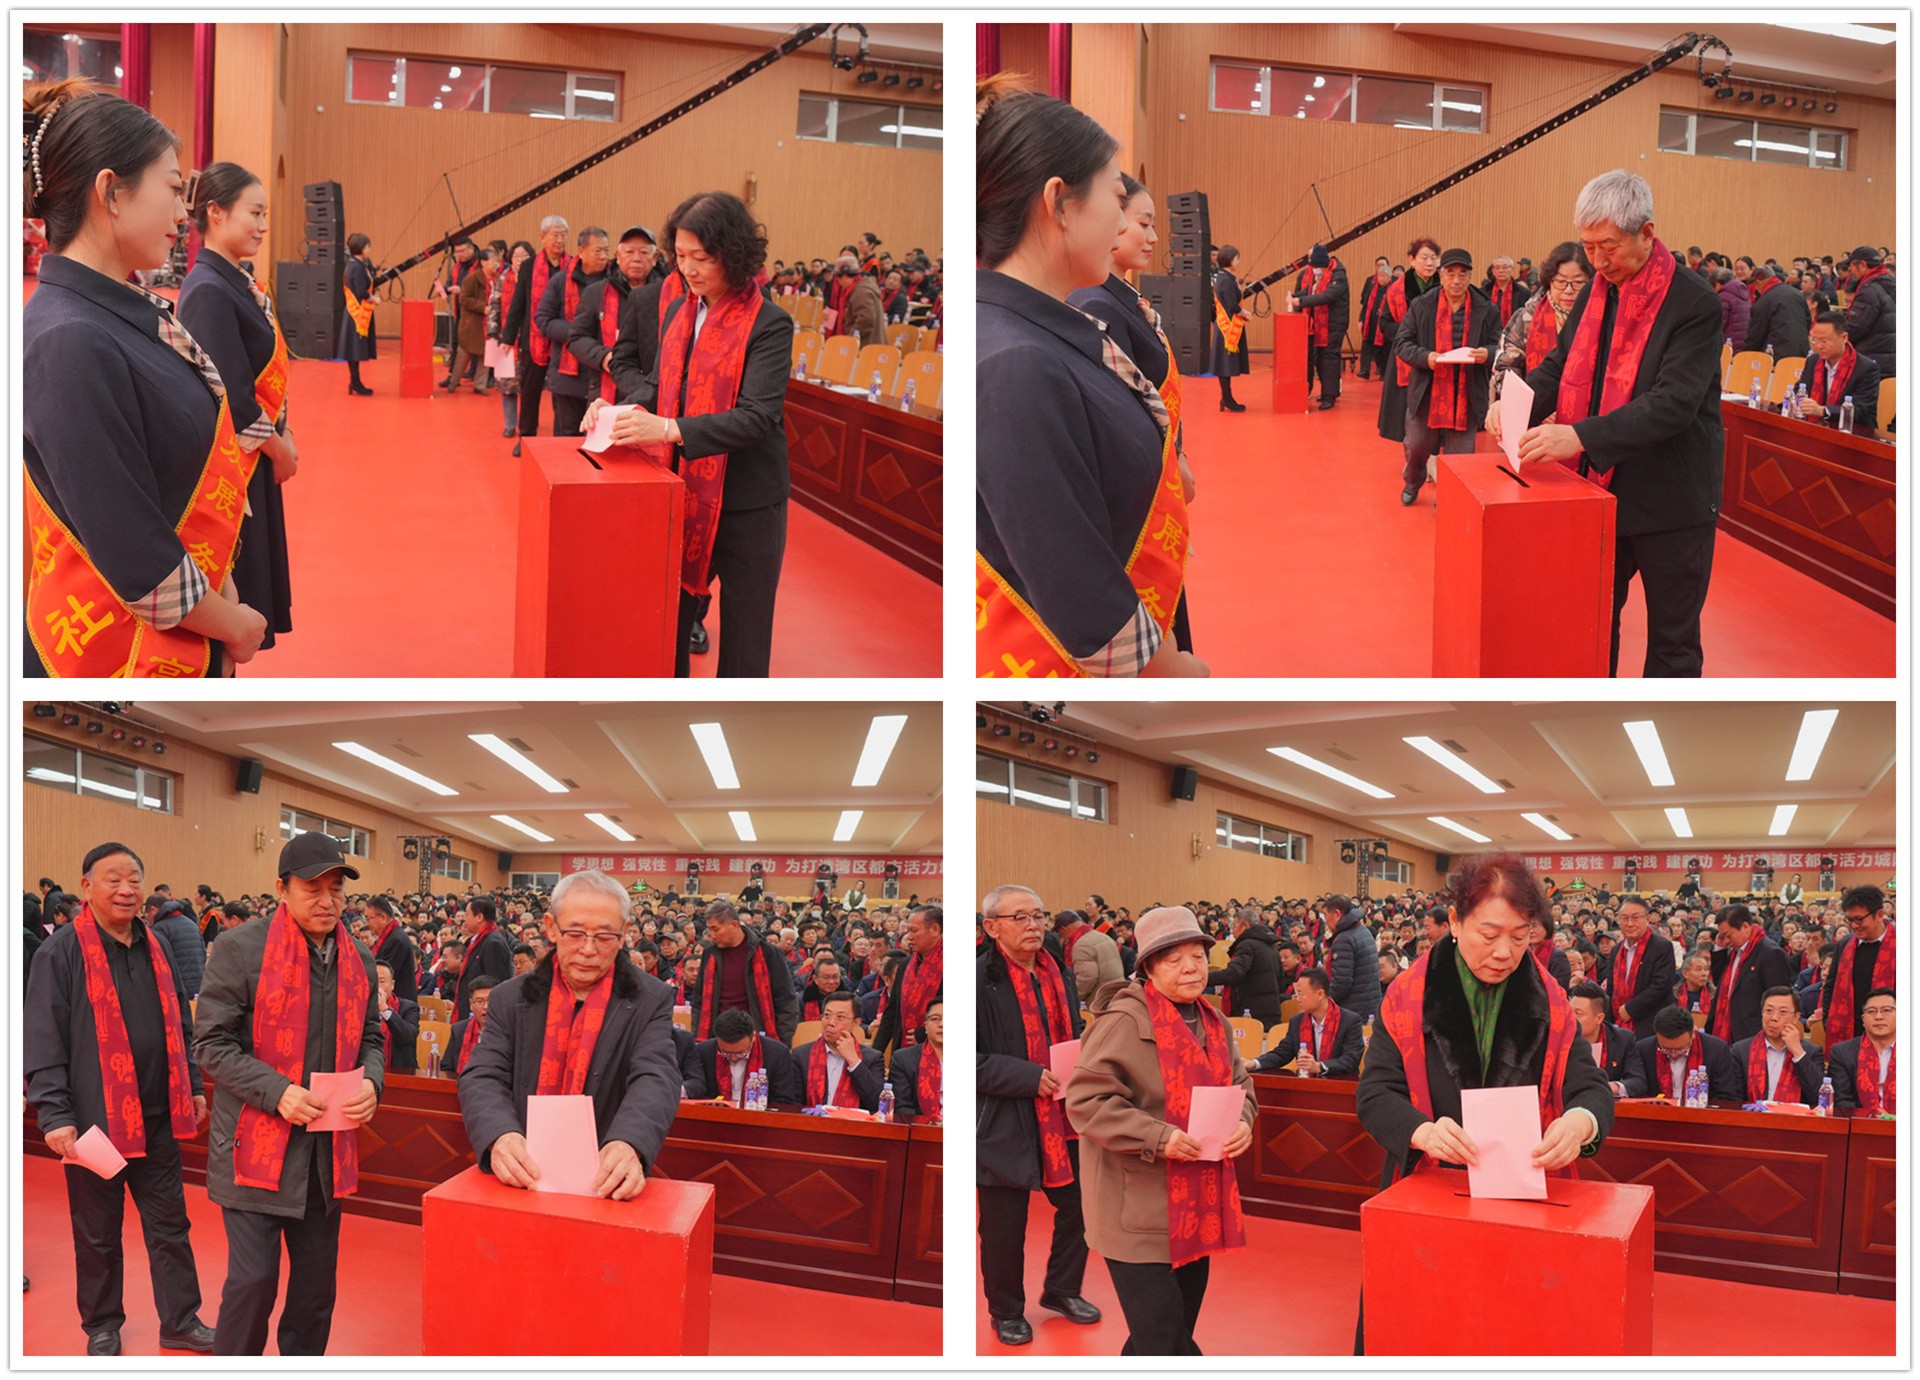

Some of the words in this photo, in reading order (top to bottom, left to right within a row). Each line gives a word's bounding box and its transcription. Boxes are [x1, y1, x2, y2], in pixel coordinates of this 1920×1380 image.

[572, 857, 614, 871] 学思想
[622, 857, 667, 872] 强党性
[785, 858, 943, 875] 为打造湾区都市活力
[1560, 855, 1604, 870] 强党性
[1722, 851, 1896, 868] 为打造湾区都市活力城
